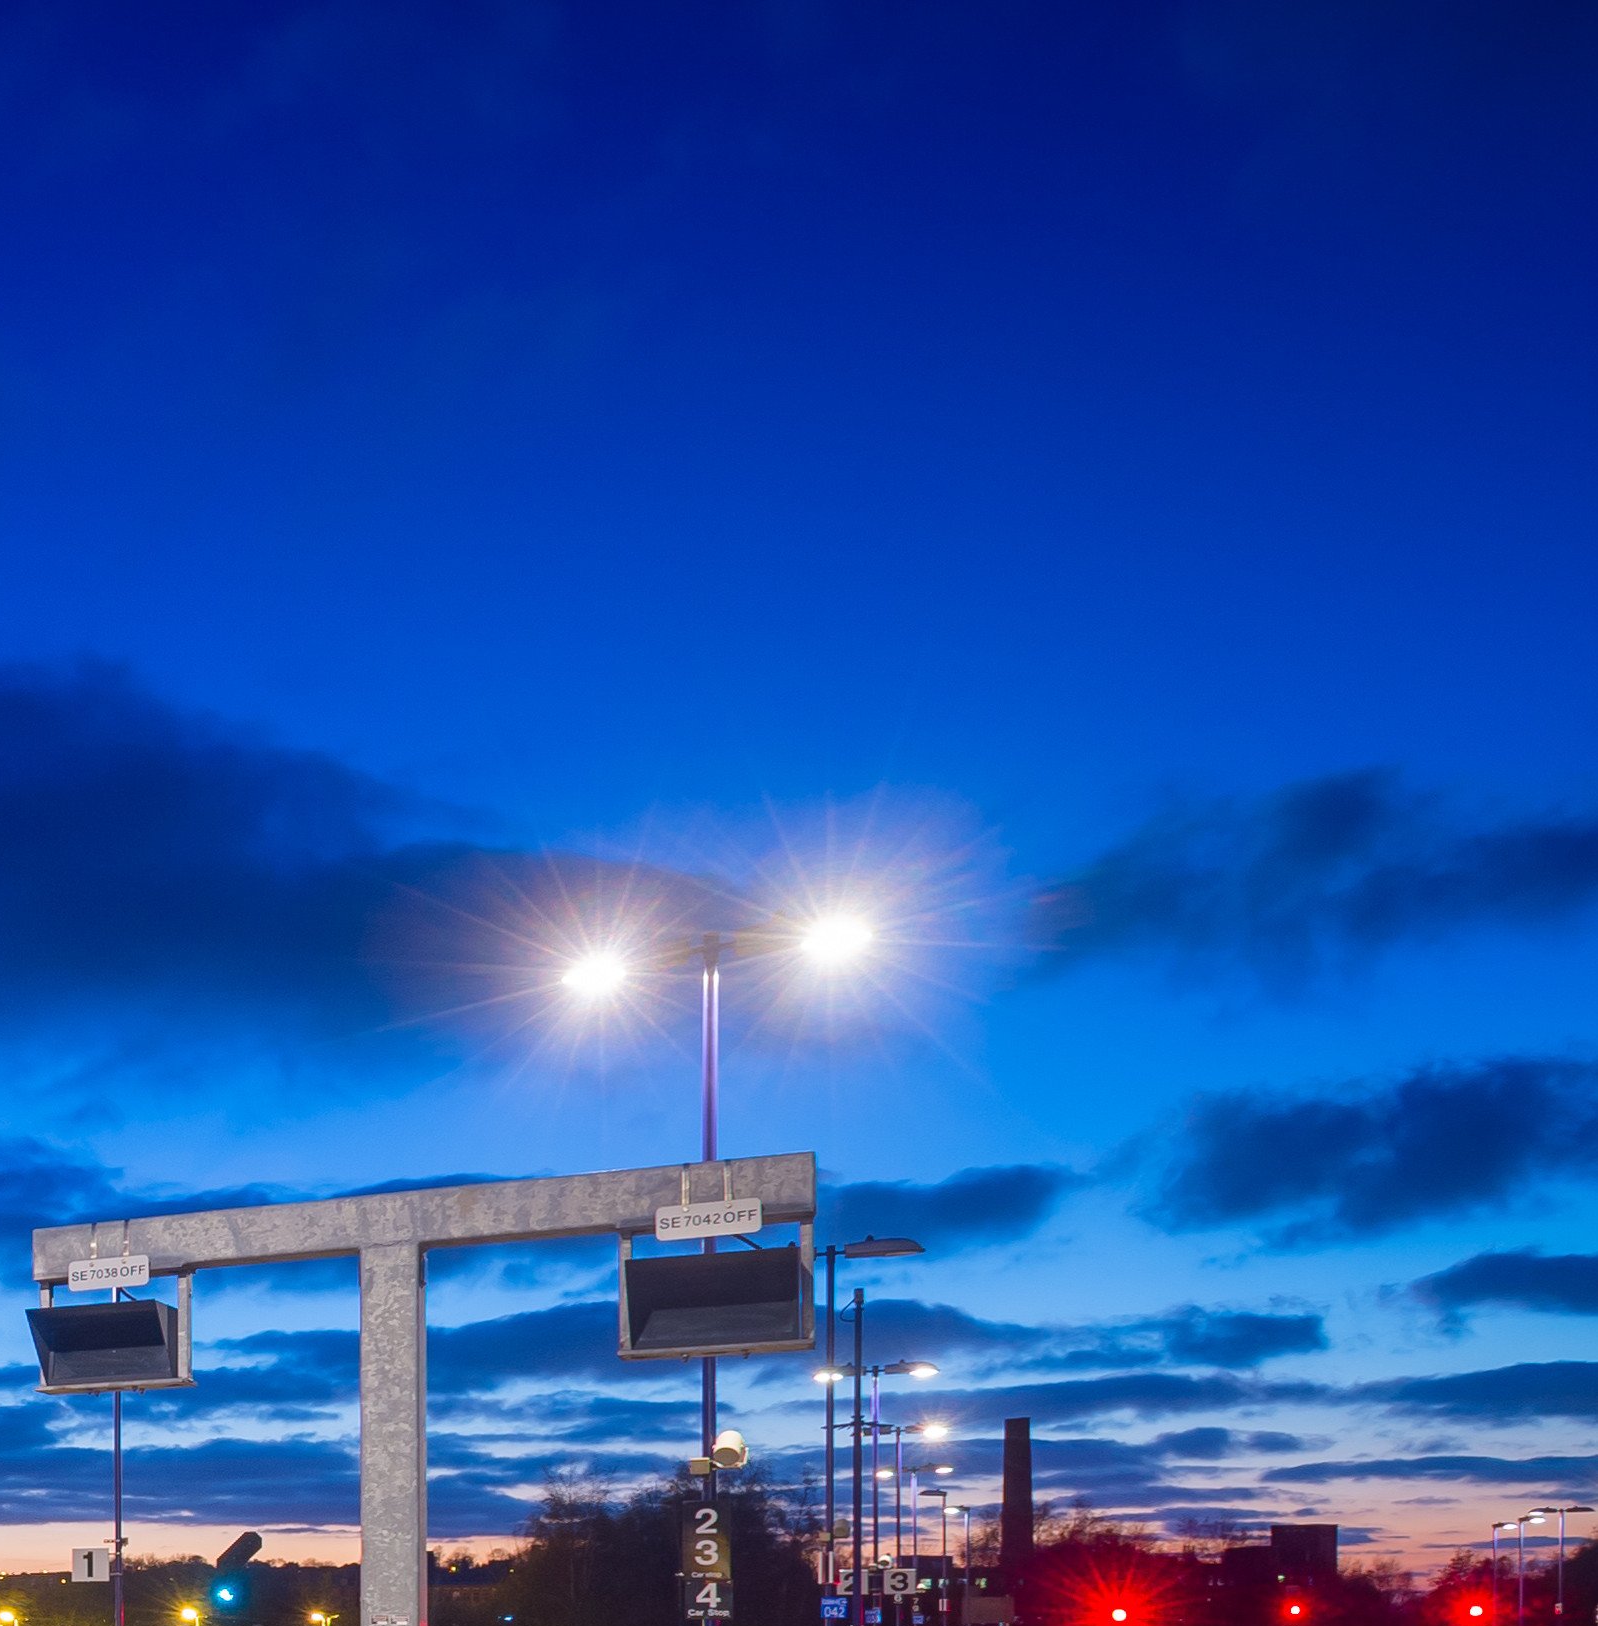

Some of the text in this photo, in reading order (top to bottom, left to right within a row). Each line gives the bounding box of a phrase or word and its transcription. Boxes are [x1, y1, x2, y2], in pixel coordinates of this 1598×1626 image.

[659, 1208, 758, 1229] SE 7042 OFF
[71, 1264, 146, 1282] SE 7038 OFF
[695, 1508, 718, 1534] 2
[694, 1539, 719, 1566] 3
[83, 1551, 94, 1578] 1
[890, 1572, 909, 1591] 3
[695, 1582, 721, 1608] 4
[687, 1608, 730, 1617] Car Stop
[824, 1606, 845, 1617] 042
